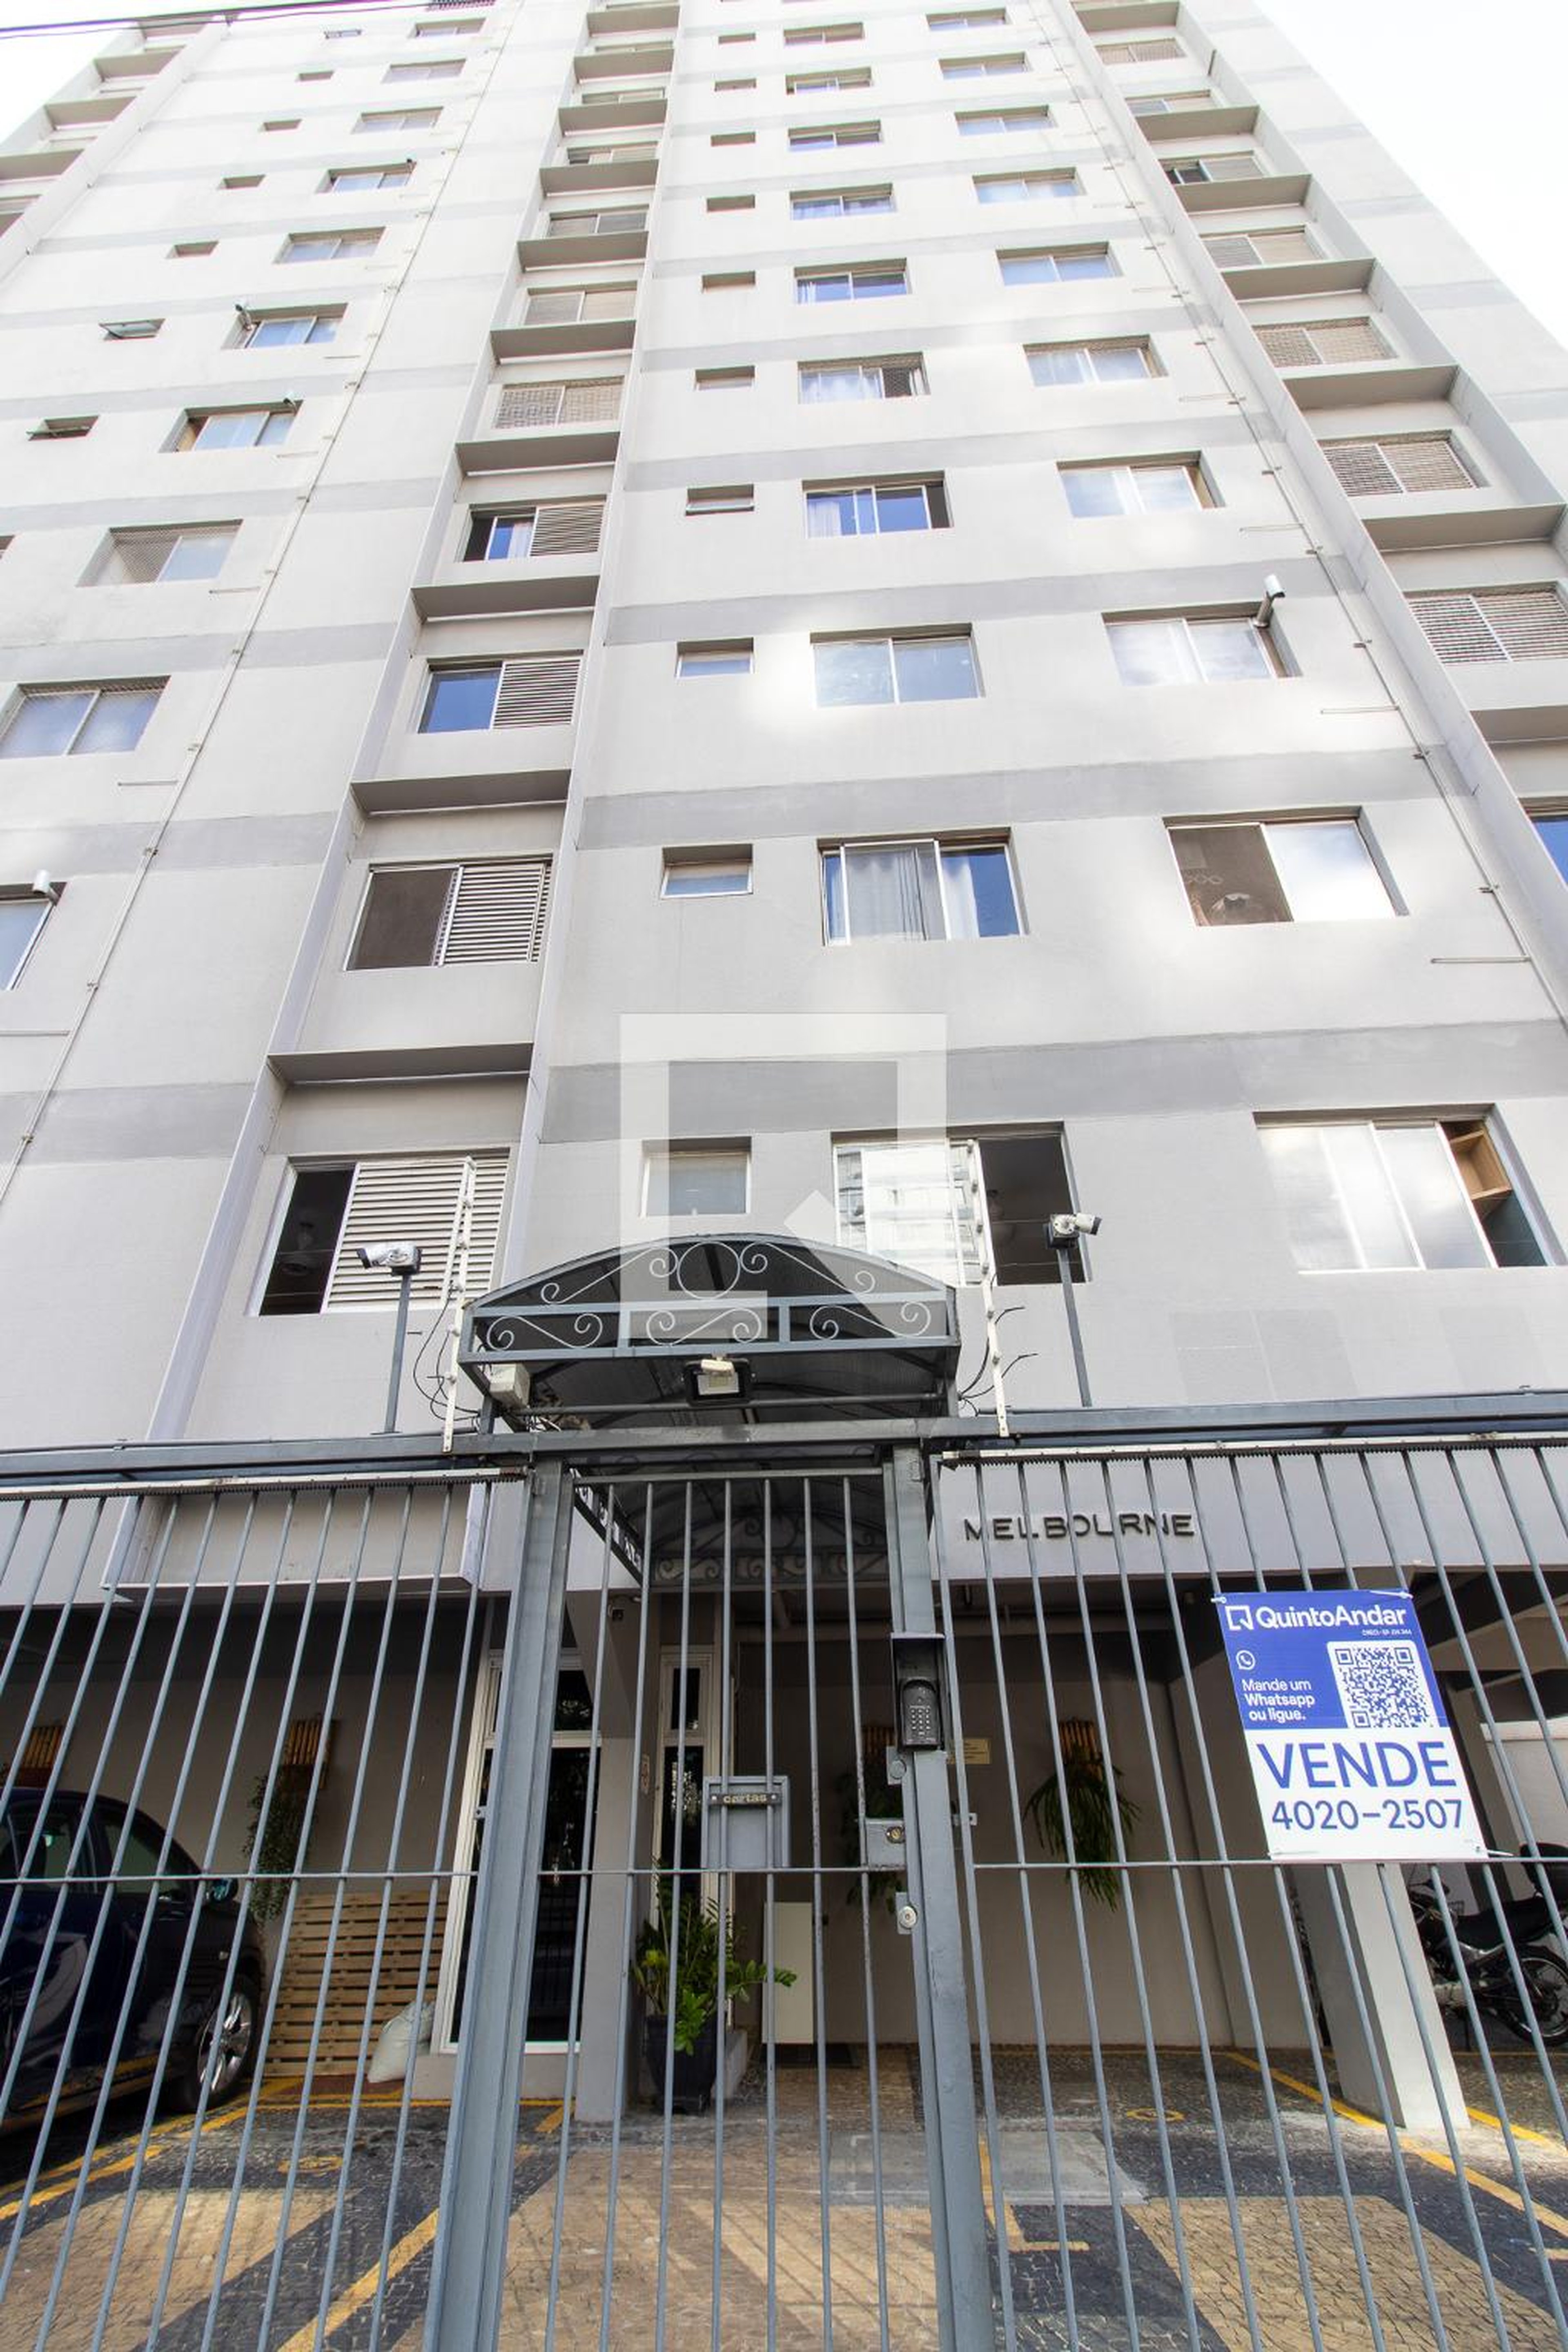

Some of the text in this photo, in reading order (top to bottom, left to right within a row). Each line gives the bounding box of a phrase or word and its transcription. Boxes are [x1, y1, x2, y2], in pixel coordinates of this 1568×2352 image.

[1256, 1605, 1406, 1629] QuintoAndar
[1242, 1678, 1312, 1691] Mande um
[1244, 1693, 1315, 1708] Whatsapp
[1249, 1707, 1306, 1724] ou ligue.
[1256, 1741, 1457, 1788] VENDE
[1272, 1799, 1462, 1830] 4020-2507
